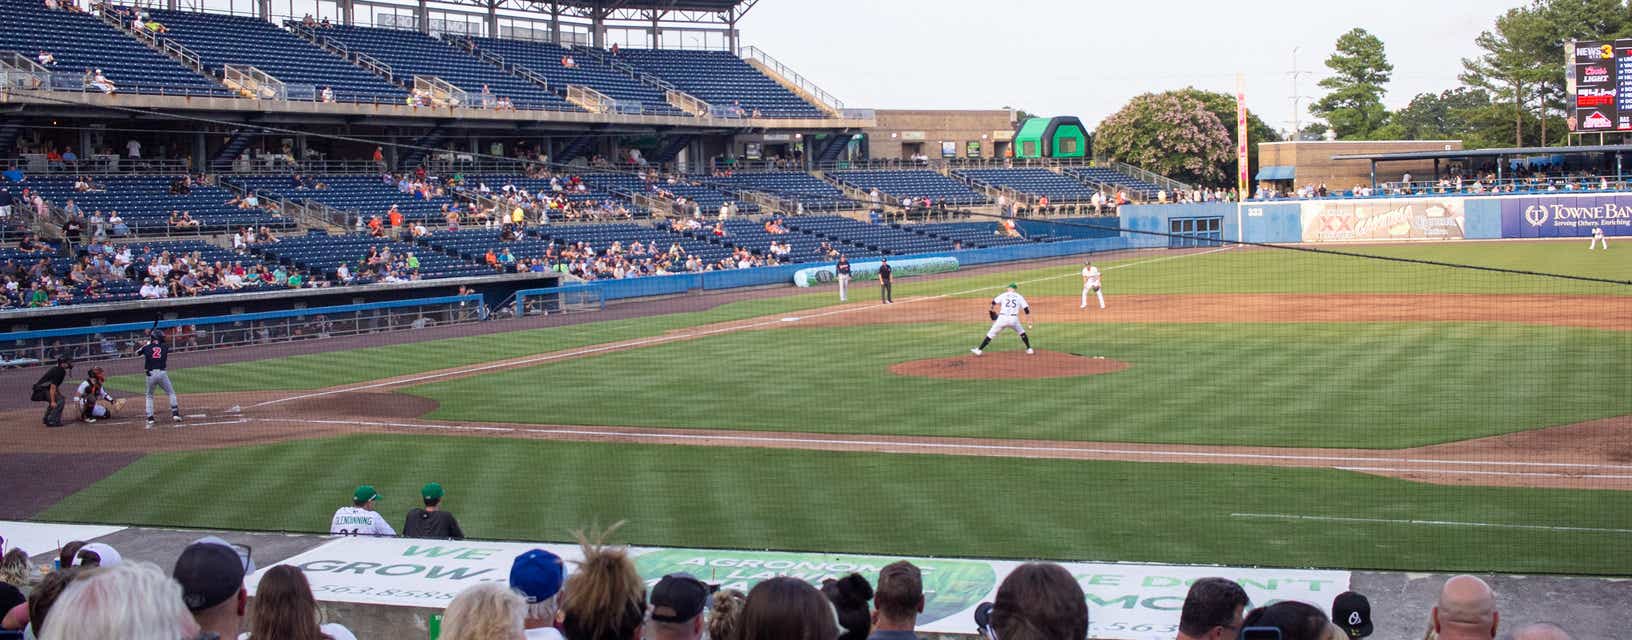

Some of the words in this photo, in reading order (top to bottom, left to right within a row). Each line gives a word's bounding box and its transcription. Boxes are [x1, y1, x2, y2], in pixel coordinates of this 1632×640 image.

[1577, 47, 1601, 56] NEWS
[1600, 44, 1613, 60] 3
[1583, 75, 1608, 83] LIGHT
[1248, 207, 1262, 216] 333
[1601, 218, 1630, 226] Enriching
[1005, 299, 1016, 308] 25
[152, 347, 161, 358] 2
[402, 544, 502, 560] WE
[1142, 576, 1333, 591] DN'T
